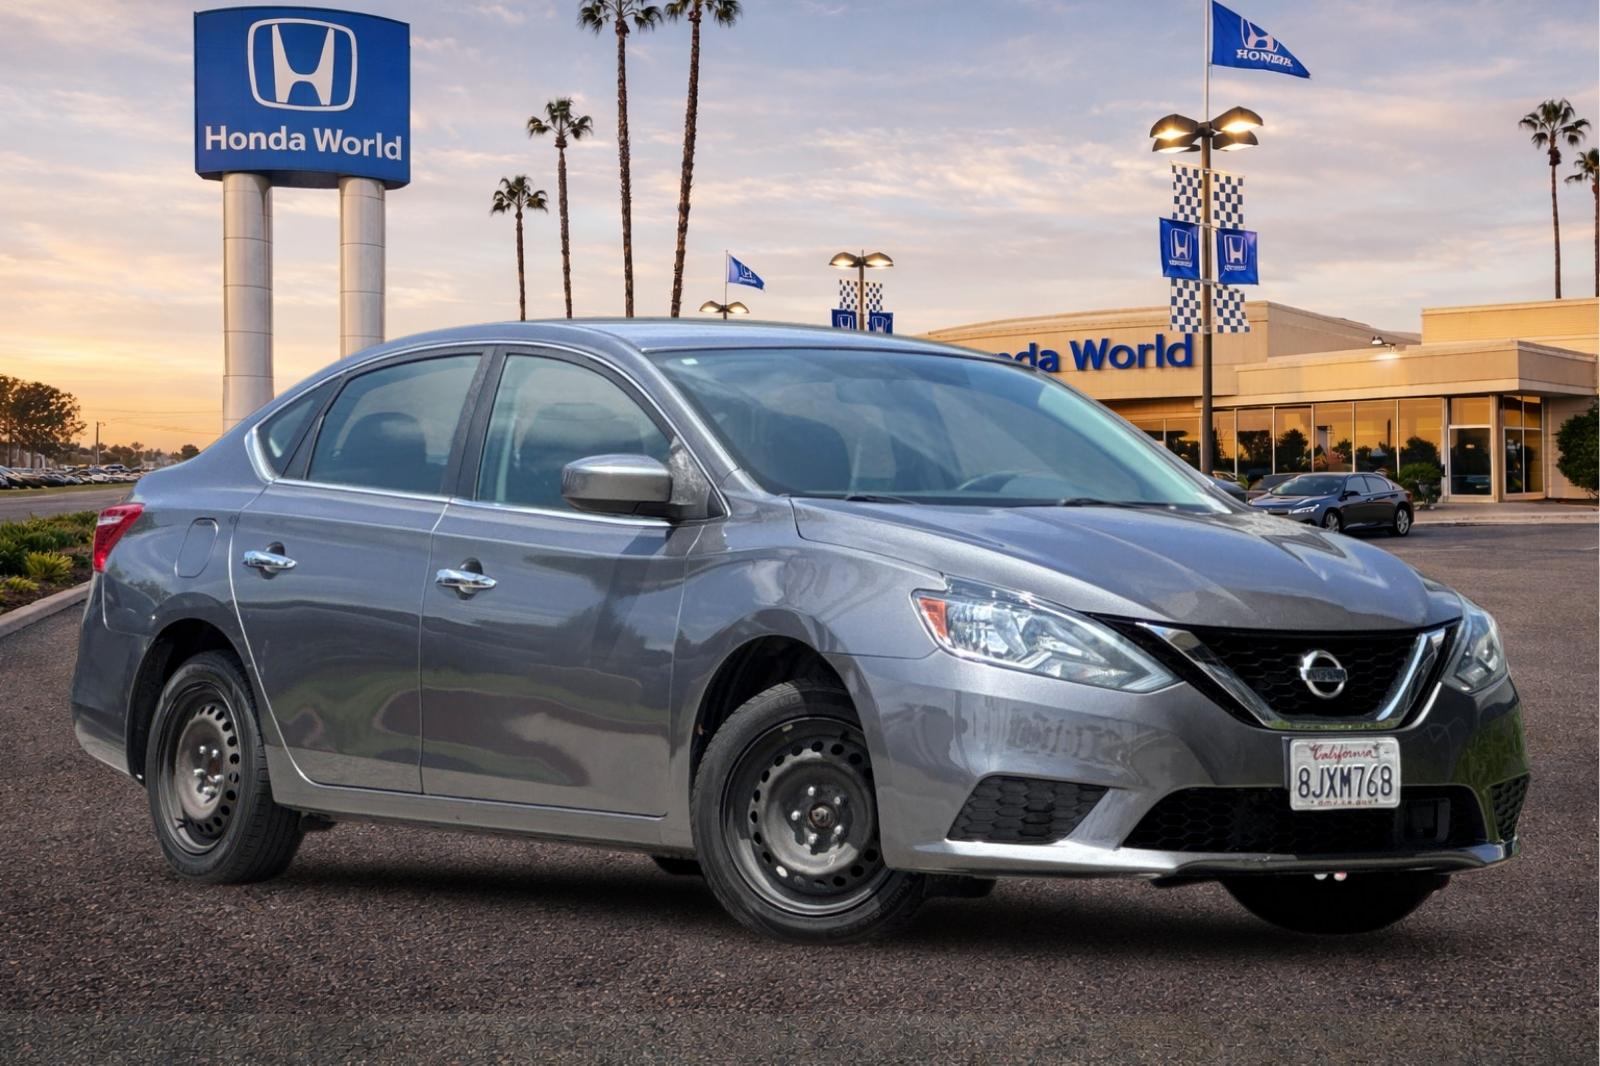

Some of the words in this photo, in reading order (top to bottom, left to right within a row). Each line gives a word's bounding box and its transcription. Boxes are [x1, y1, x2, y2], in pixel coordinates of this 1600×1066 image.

[205, 125, 306, 151] Honda
[313, 127, 402, 161] World
[1069, 333, 1194, 371] World
[1310, 743, 1378, 764] California
[1298, 766, 1393, 798] 8JXM768
